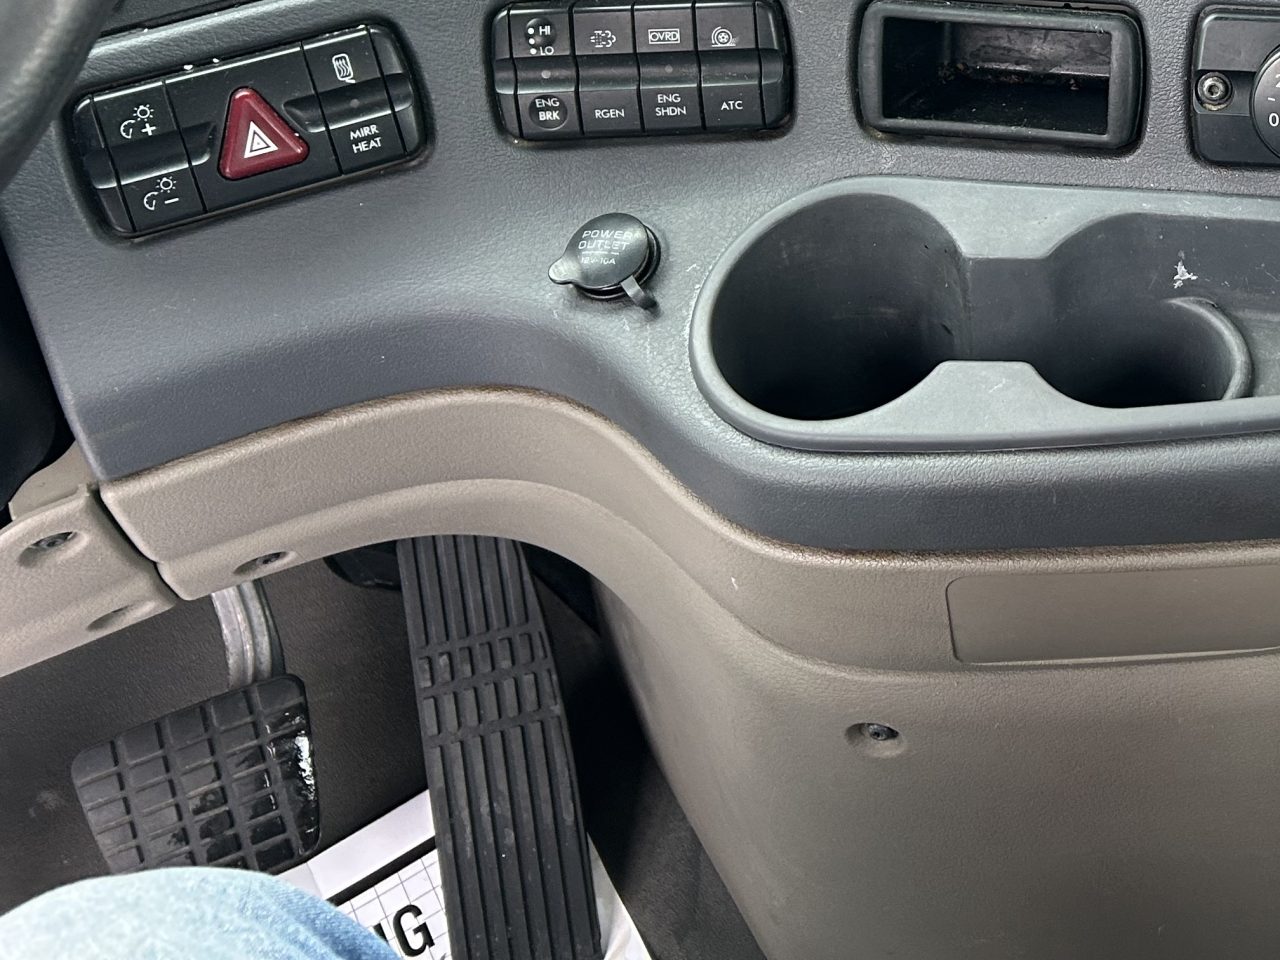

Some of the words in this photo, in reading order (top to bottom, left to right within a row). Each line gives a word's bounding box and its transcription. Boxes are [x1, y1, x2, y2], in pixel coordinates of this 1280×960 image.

[538, 25, 551, 35] HI
[650, 30, 679, 42] OVRD
[539, 45, 555, 56] LO
[535, 98, 560, 109] ENG
[658, 93, 681, 104] ENG
[655, 105, 687, 117] SHDN
[720, 100, 743, 111] ATC
[538, 110, 560, 121] BRK
[594, 108, 625, 120] RGEN
[1268, 112, 1280, 127] 0
[350, 124, 380, 141] MIRR
[352, 137, 383, 154] HEAT
[581, 229, 632, 240] POWER
[578, 240, 631, 251] OUTLET
